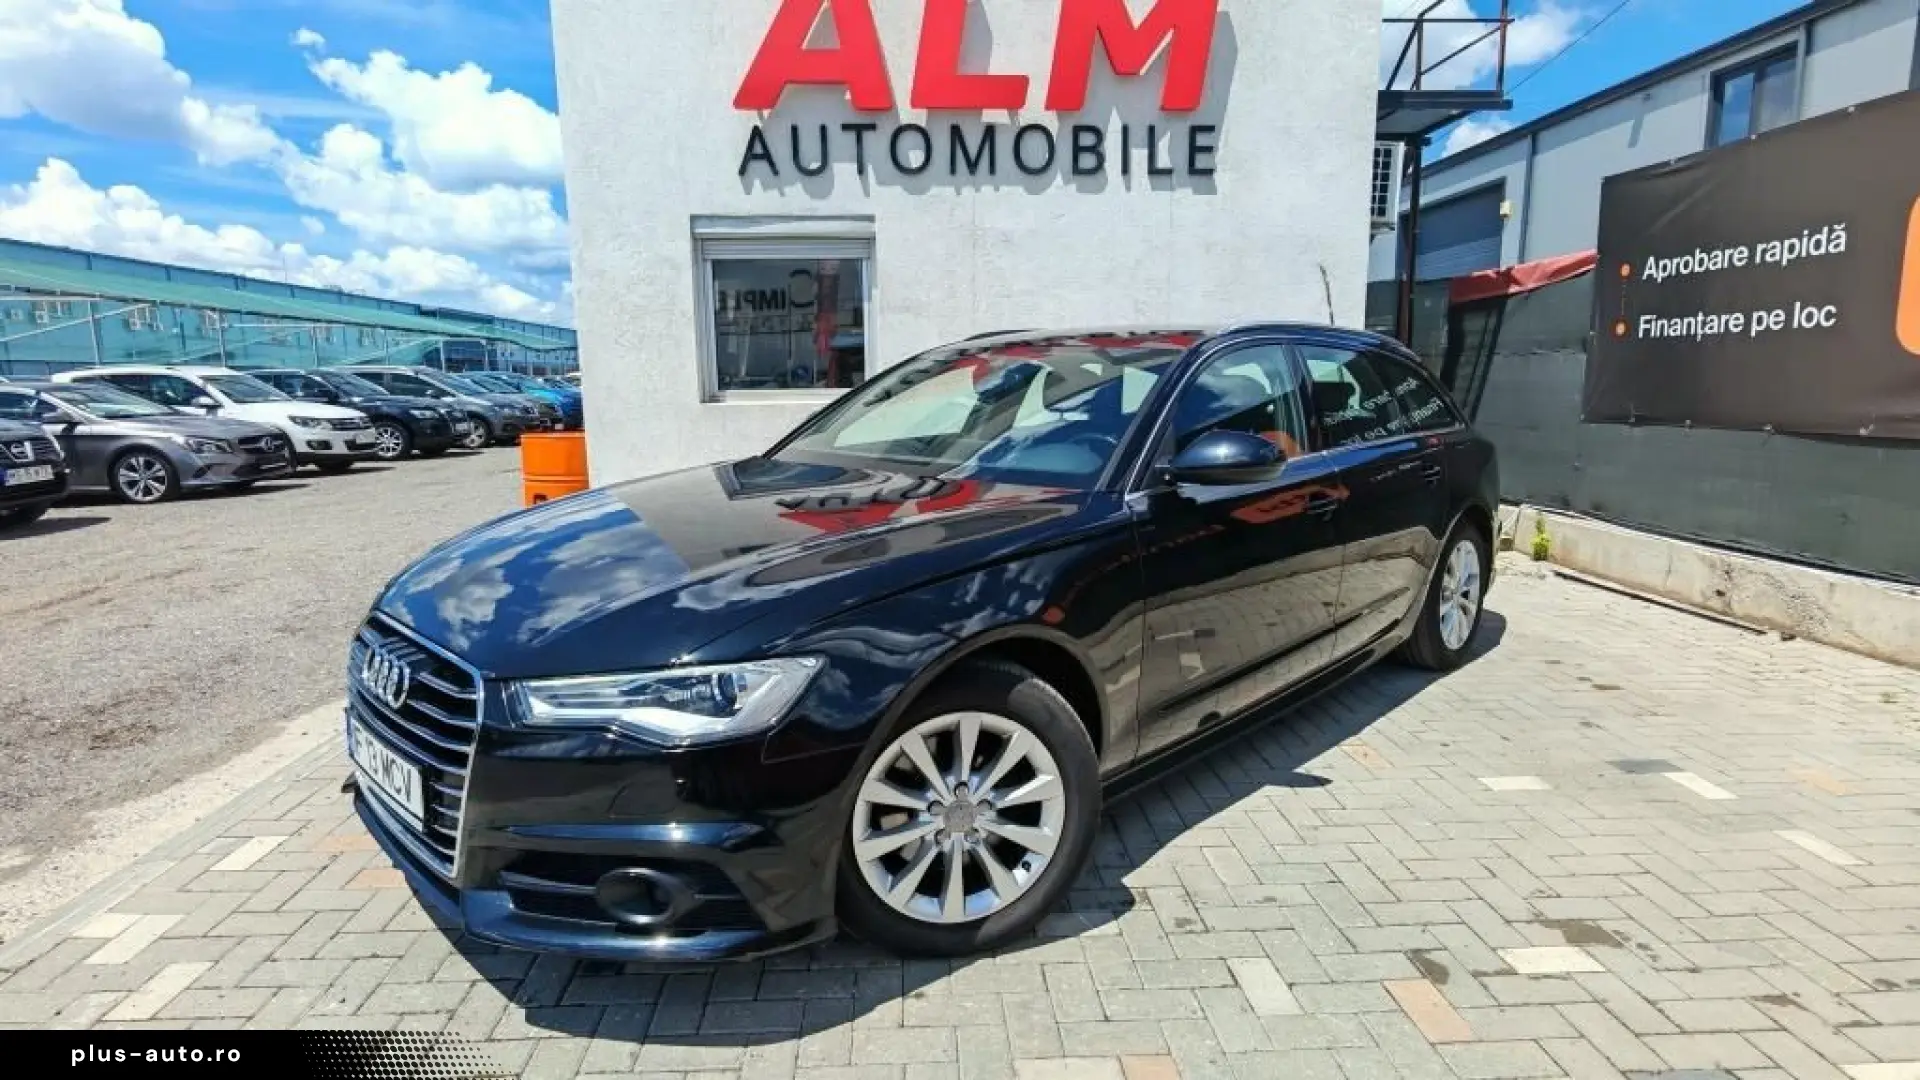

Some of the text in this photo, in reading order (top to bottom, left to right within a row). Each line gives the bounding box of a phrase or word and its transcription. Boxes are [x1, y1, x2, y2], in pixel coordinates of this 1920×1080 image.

[733, 0, 1220, 111] ALM
[738, 123, 1216, 178] AUTOMOBILE
[1641, 222, 1847, 284] Aprobare rapidă
[1637, 301, 1838, 342] Finanțare pe loc
